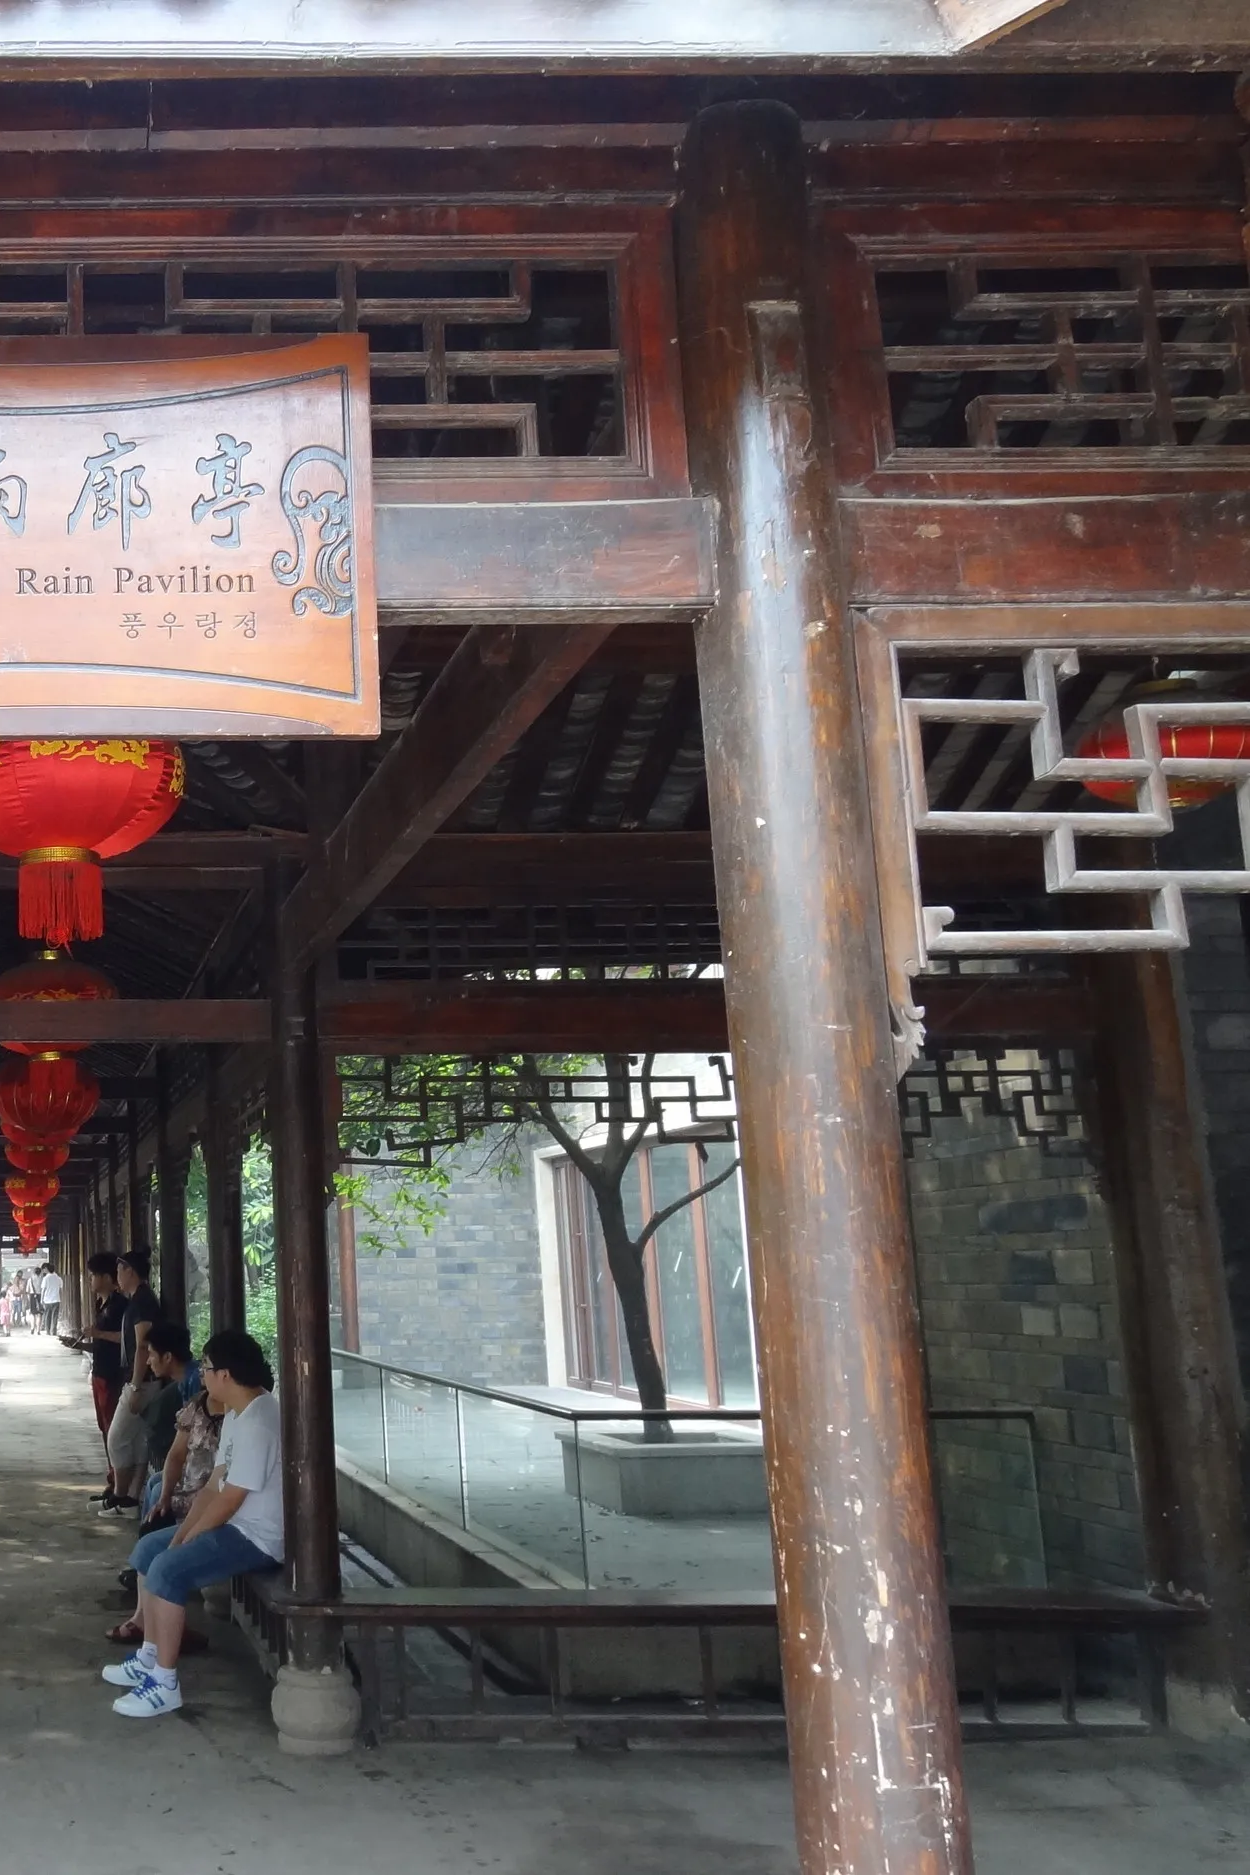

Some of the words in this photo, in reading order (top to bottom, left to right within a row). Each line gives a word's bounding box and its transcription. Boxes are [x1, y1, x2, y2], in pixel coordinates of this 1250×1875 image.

[16, 567, 95, 595] Rain
[114, 565, 256, 594] Pavilion
[118, 611, 259, 639] 풍우랑정
